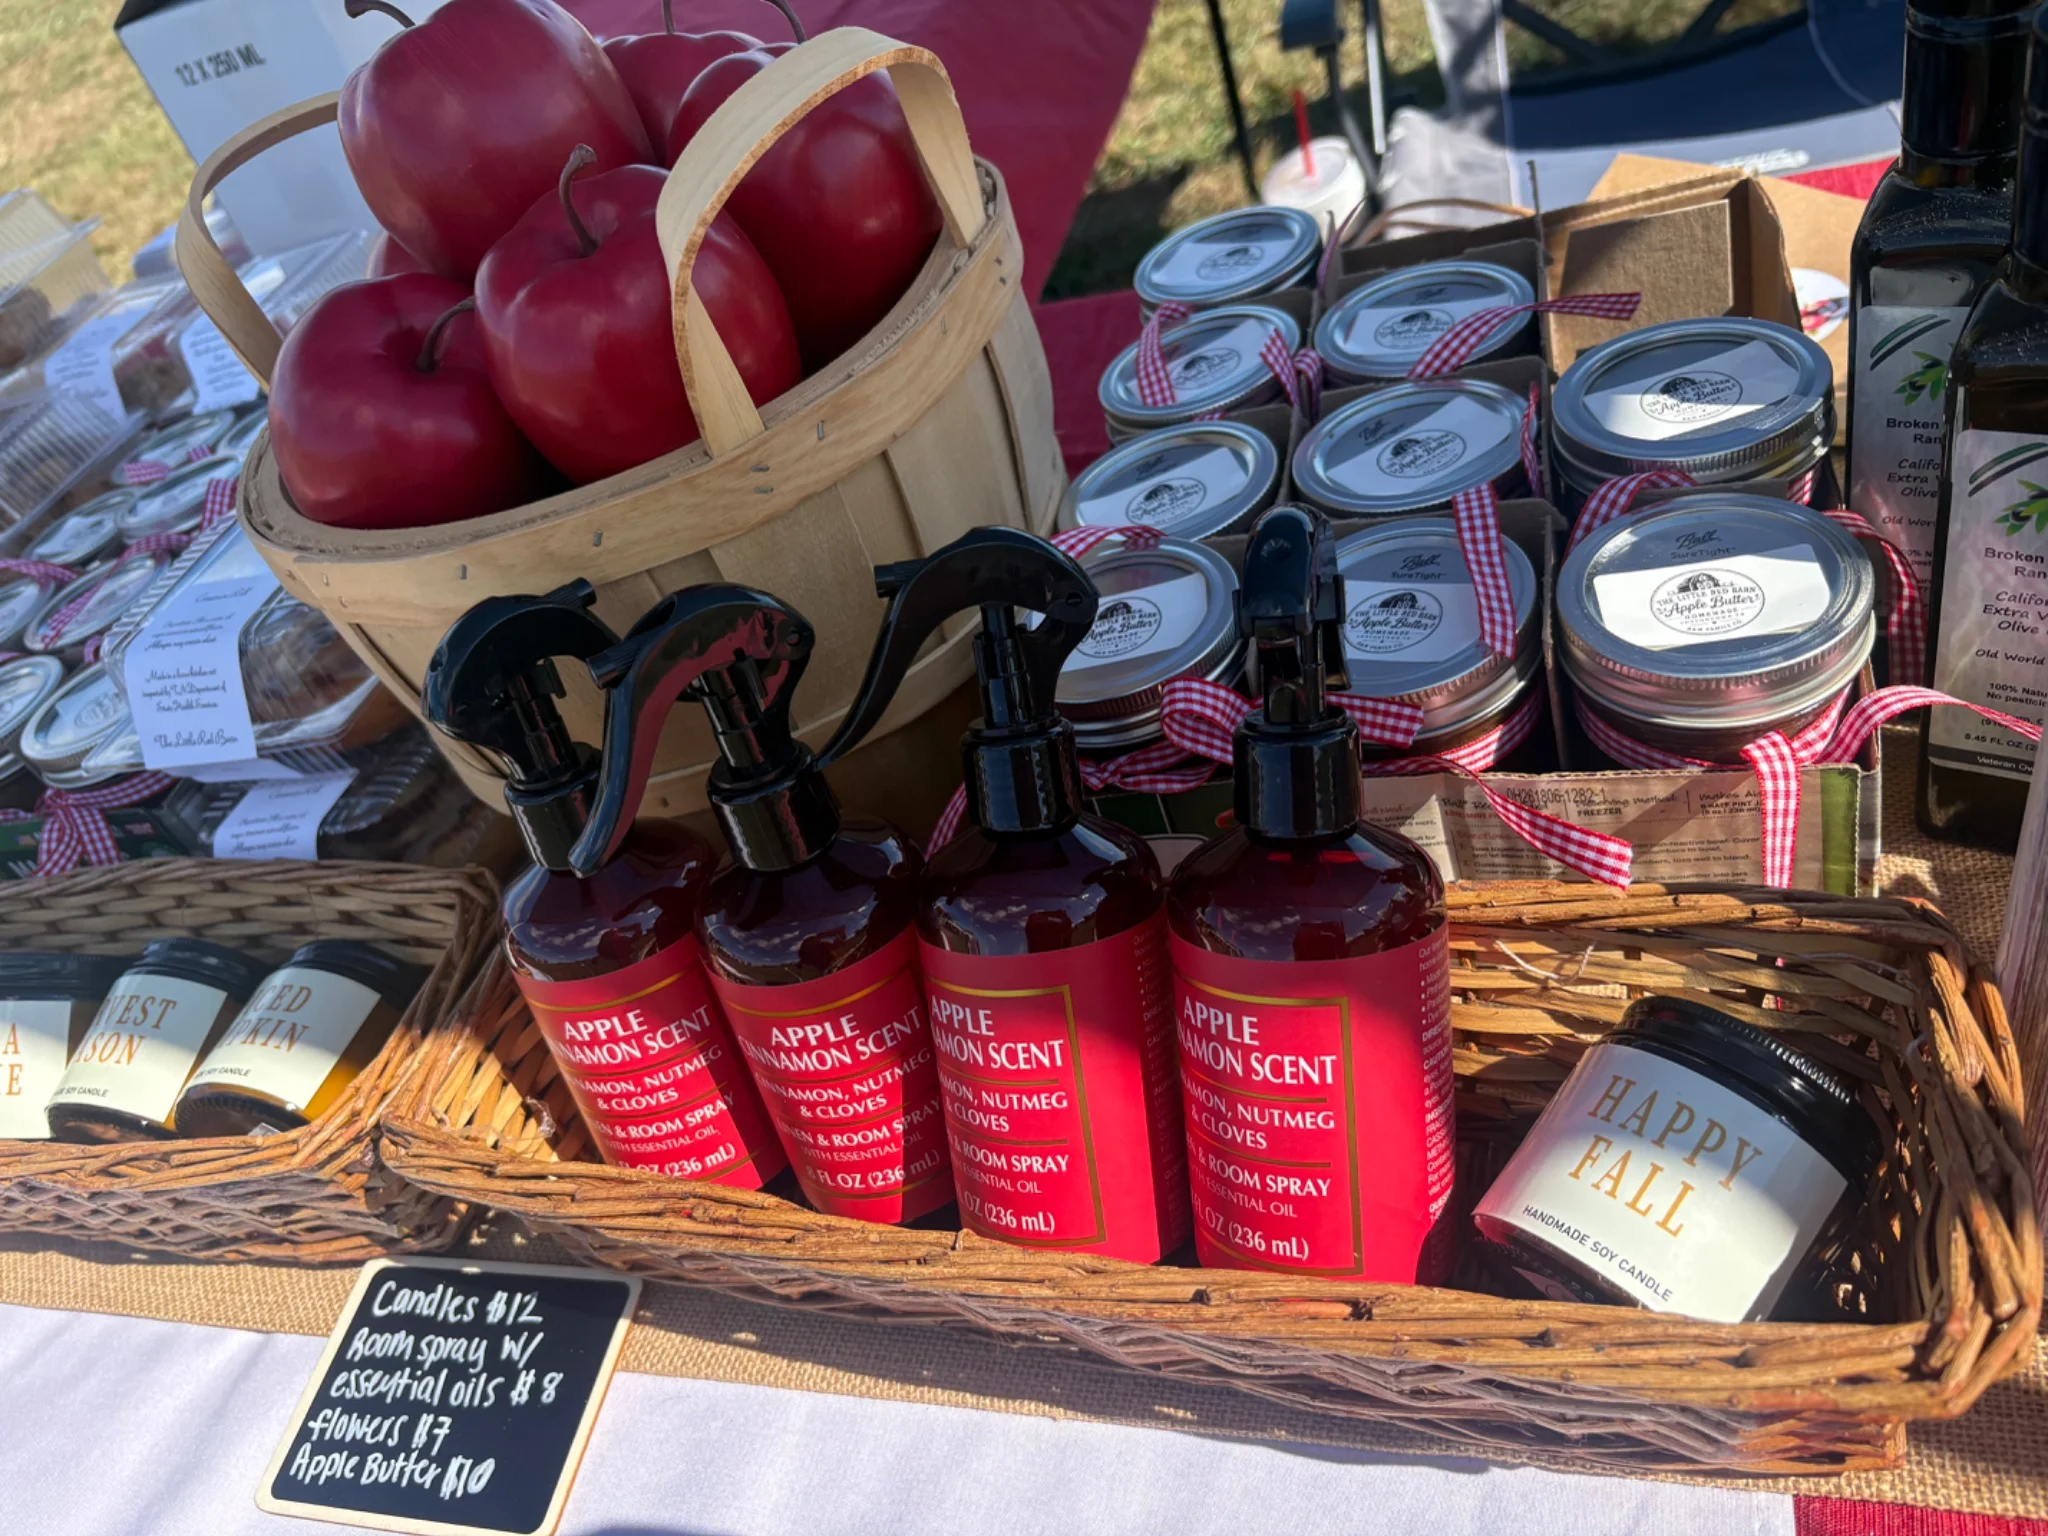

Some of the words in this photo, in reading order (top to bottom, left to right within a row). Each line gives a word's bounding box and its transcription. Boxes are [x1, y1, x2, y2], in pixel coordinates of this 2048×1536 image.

[174, 62, 200, 87] 12
[236, 42, 267, 69] ML
[1886, 417, 1940, 430] Broken
[1912, 432, 1943, 445] Ran
[1887, 472, 1929, 484] Extra
[1897, 458, 1941, 471] Califo
[1901, 485, 1939, 498] Olive
[1907, 516, 1936, 528] Wor
[1983, 546, 2045, 565] Broken
[2013, 565, 2048, 580] Ran
[1664, 598, 1709, 618] Apple
[1710, 594, 1756, 610] Butter
[1982, 603, 2030, 620] Extra
[1995, 590, 2048, 607] Califor
[1997, 619, 2040, 635] Olive
[1975, 648, 1999, 660] Old
[2004, 651, 2046, 666] World
[1986, 691, 2002, 700] No
[2004, 694, 2047, 708] pestici
[1989, 682, 2019, 694] 100%
[2021, 687, 2048, 699] Natu
[1990, 736, 2004, 746] FL
[2005, 739, 2023, 749] OZ
[1976, 755, 2016, 769] Veteran
[1576, 807, 1622, 817] FREEZER
[564, 1008, 648, 1042] APPLE
[770, 1013, 861, 1049] APPLE
[931, 994, 996, 1037] APPLE
[1183, 995, 1260, 1047] APPLE
[555, 1039, 641, 1066] NAMON
[642, 1004, 711, 1057] SCENT
[854, 1005, 922, 1061] SCENT
[931, 1025, 985, 1067] AMON
[988, 1039, 1065, 1071] SCENT
[572, 1076, 643, 1096] NAMON,
[643, 1045, 723, 1087] NUTMEG
[852, 1047, 931, 1097] NUTMEG
[1250, 1051, 1337, 1086] SCENT
[78, 1086, 110, 1098] CANDLE
[597, 1096, 610, 1112] &
[611, 1086, 680, 1112] CLOVES
[800, 1105, 813, 1119] &
[815, 1093, 888, 1120] CLOVES
[981, 1089, 1068, 1112] NUTMEG
[615, 1124, 628, 1139] &
[627, 1117, 685, 1139] ROOM
[685, 1092, 735, 1128] SPRAY
[816, 1133, 831, 1148] &
[831, 1125, 891, 1148] ROOM
[892, 1096, 941, 1134] SPRAY
[954, 1102, 1010, 1133] CLOVES
[1201, 1112, 1268, 1150] CLOVES
[1236, 1102, 1336, 1130] NUTMEG
[631, 1134, 694, 1154] ESSENTIAL
[1587, 1073, 1764, 1193] HAPPY
[664, 1156, 703, 1178] (236
[704, 1141, 737, 1168] mL)
[834, 1142, 901, 1163] ESSENTIAL
[836, 1172, 868, 1189] OZ
[867, 1163, 905, 1188] (236
[910, 1149, 941, 1176] mL)
[962, 1140, 1009, 1171] ROOM
[1010, 1154, 1069, 1174] SPRAY
[1016, 1179, 1043, 1194] OIL
[1208, 1153, 1262, 1190] ROOM
[1266, 1174, 1332, 1198] SPRAY
[1567, 1133, 1696, 1238] FALL
[1206, 1177, 1267, 1213] ESSENTIAL
[1269, 1200, 1298, 1218] OIL
[984, 1202, 1018, 1229] (236
[1020, 1211, 1056, 1234] mL)
[1205, 1206, 1226, 1236] OZ
[1228, 1220, 1266, 1251] (236
[1271, 1237, 1310, 1261] mL)
[1521, 1204, 1592, 1247] HANDMADE
[1590, 1240, 1620, 1264] SOY
[1618, 1258, 1674, 1302] CANDLE
[371, 1279, 479, 1323] Candles
[485, 1290, 544, 1326] $12
[345, 1326, 415, 1362] Room
[416, 1333, 489, 1374] spray
[329, 1366, 449, 1407] essential
[449, 1373, 506, 1408] oils
[307, 1406, 410, 1448] flowers
[411, 1412, 453, 1456] $7
[288, 1441, 360, 1486] Apple
[360, 1448, 442, 1489] Butter
[440, 1454, 496, 1500] $10
